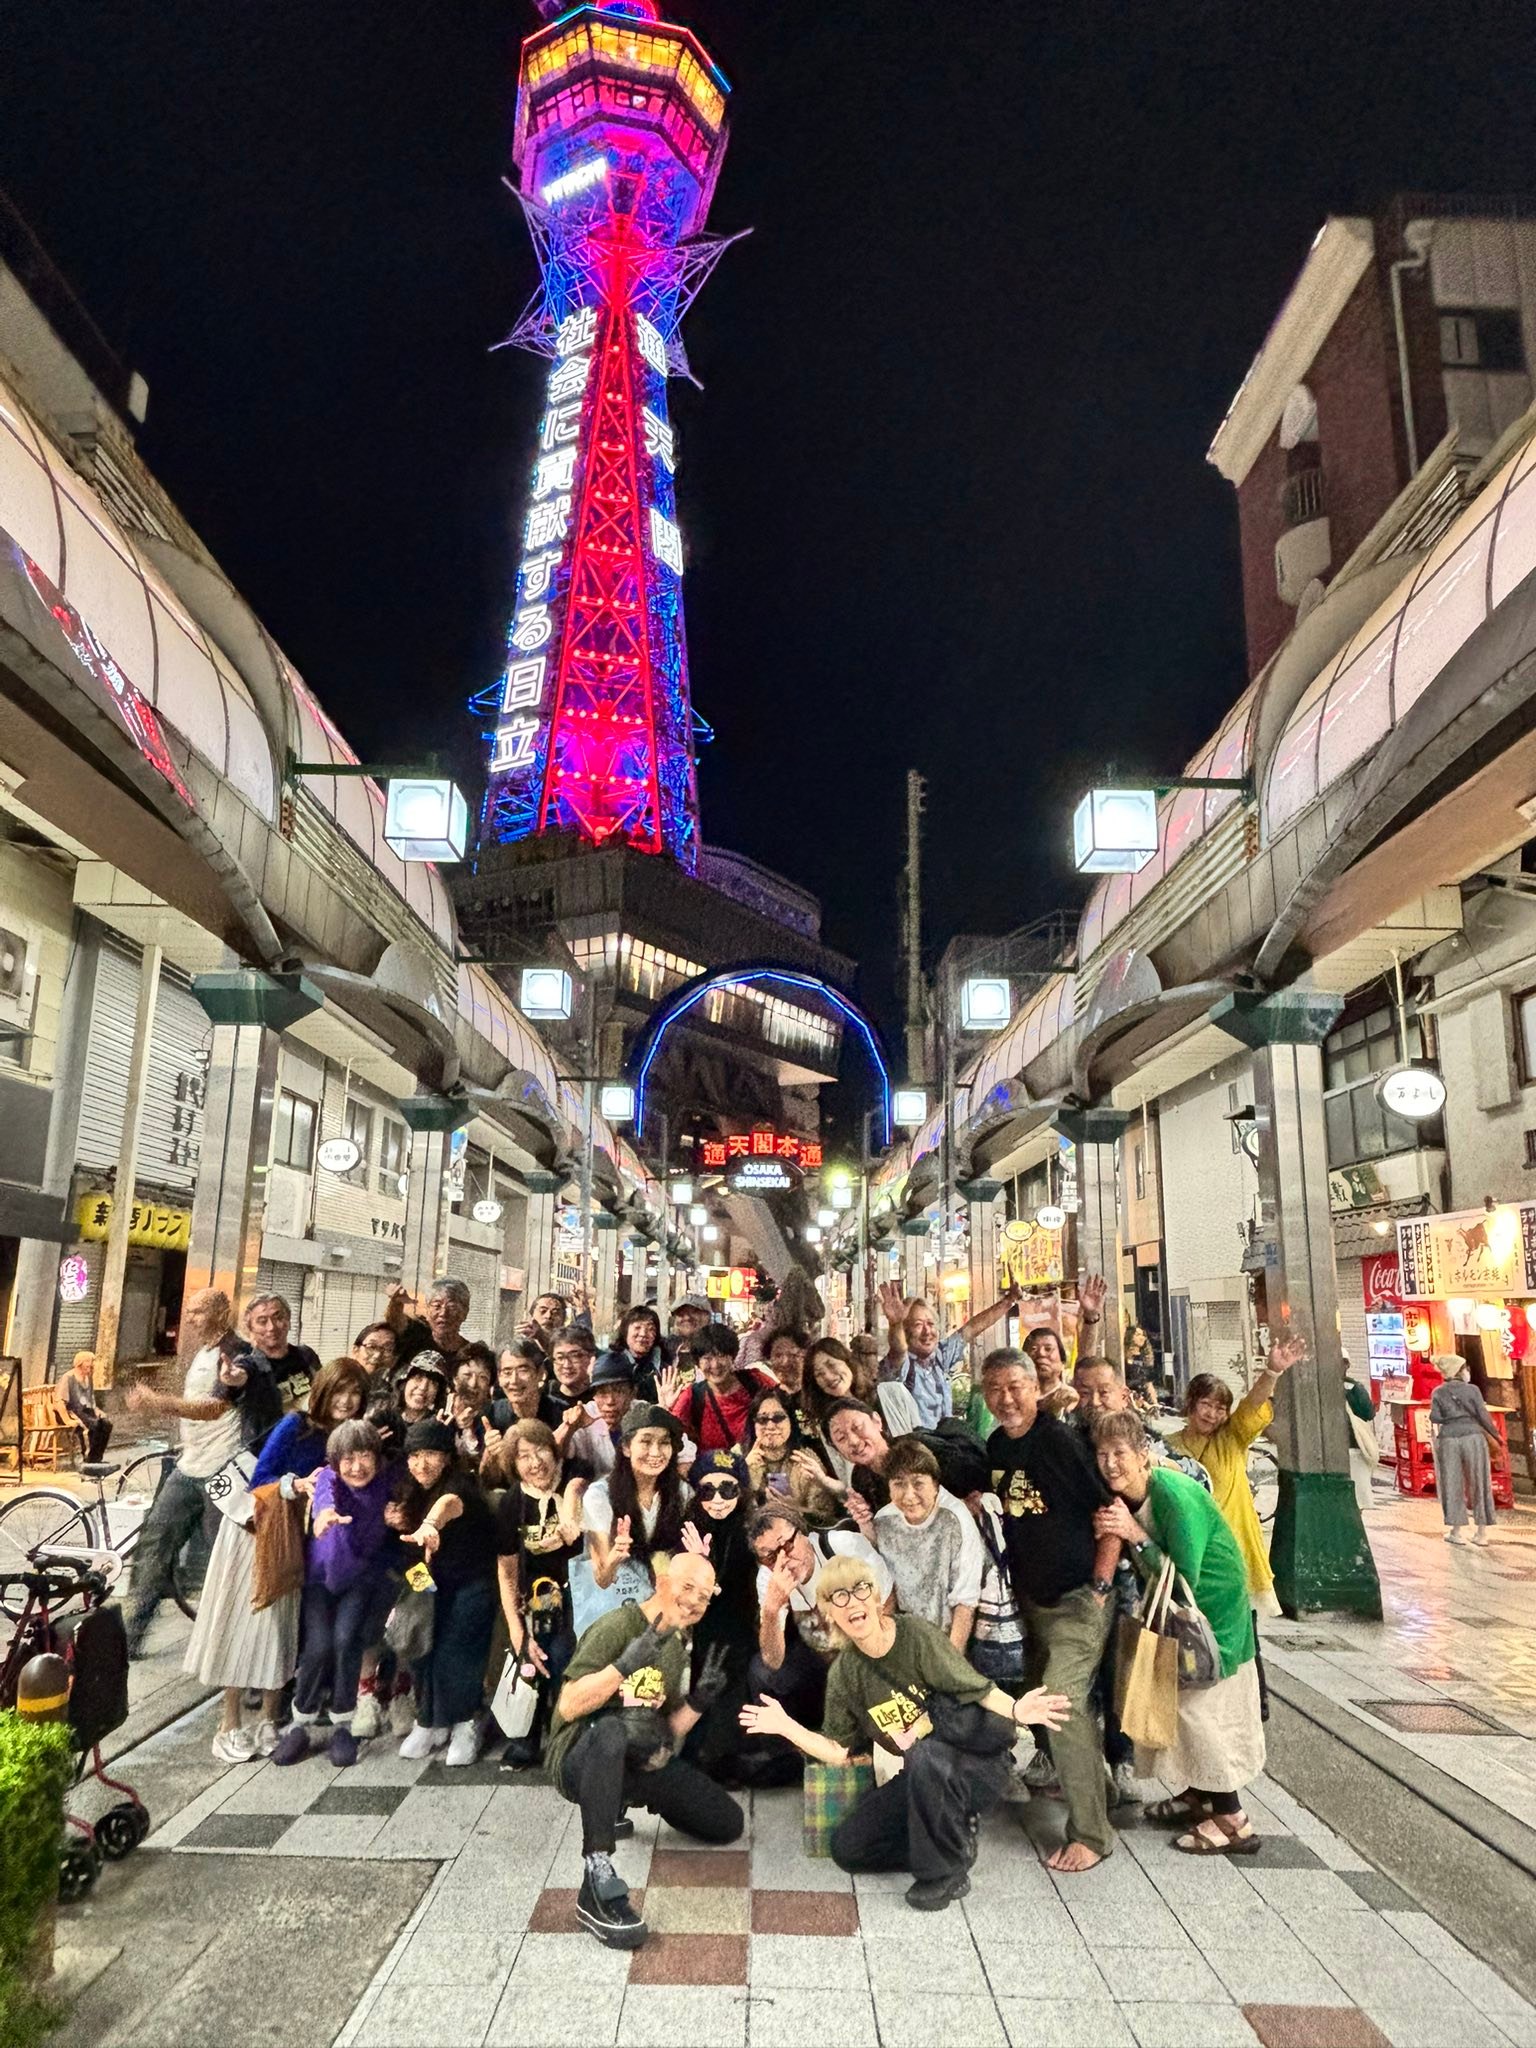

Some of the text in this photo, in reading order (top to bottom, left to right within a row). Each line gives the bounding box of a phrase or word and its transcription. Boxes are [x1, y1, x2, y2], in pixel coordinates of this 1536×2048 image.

[637, 312, 684, 576] 通天閣
[491, 306, 597, 773] 社会に貢献する日立
[704, 1133, 822, 1167] 通天閣本通
[735, 1176, 790, 1188] SHINSEKAI
[743, 1164, 782, 1175] OSAKA
[1405, 1311, 1419, 1345] ホルモン
